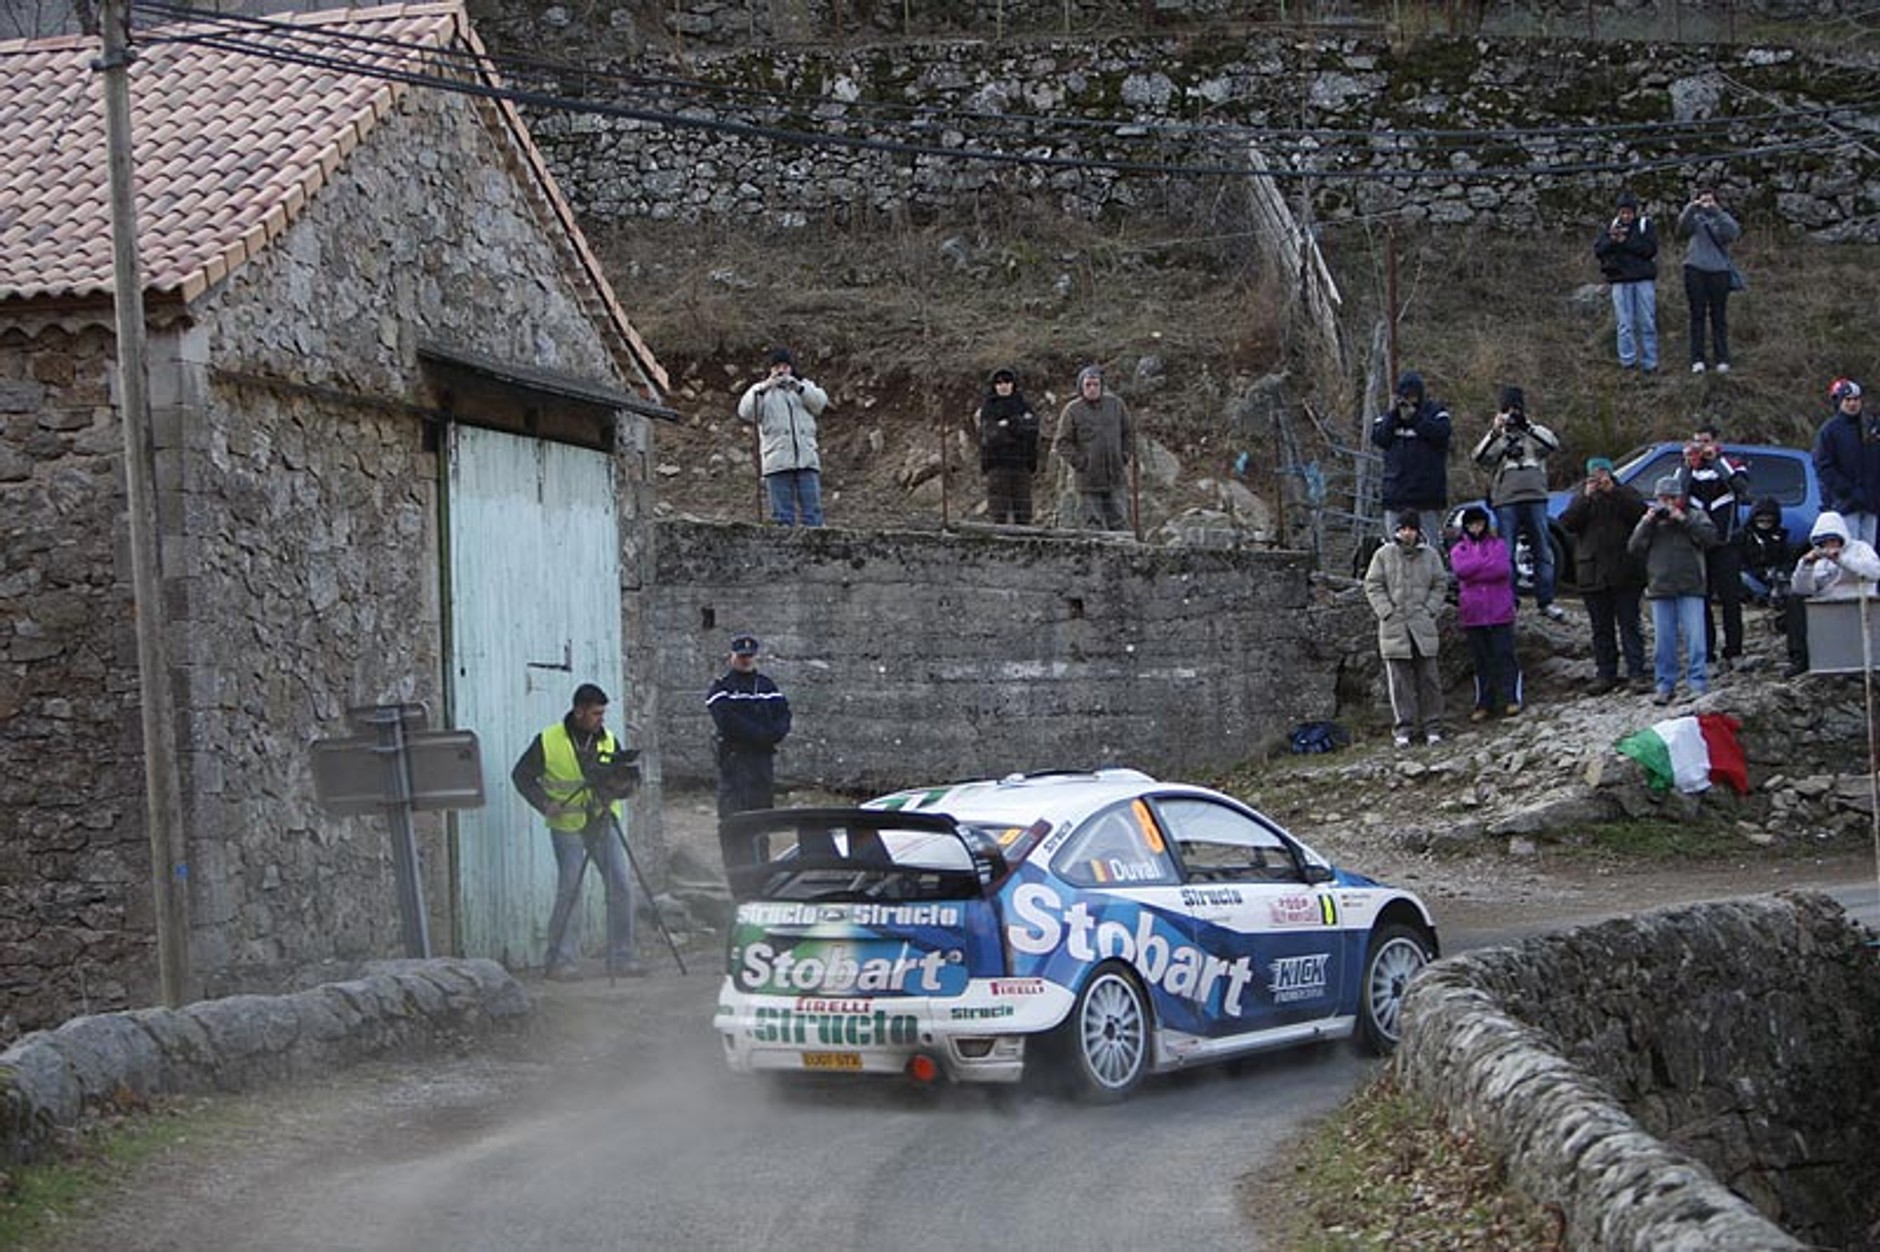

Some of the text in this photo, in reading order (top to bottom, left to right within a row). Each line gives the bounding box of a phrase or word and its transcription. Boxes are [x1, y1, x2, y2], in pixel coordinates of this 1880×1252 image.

[1131, 798, 1165, 854] 8
[1109, 858, 1161, 880] Duval
[852, 904, 958, 926] Structo
[741, 942, 946, 991] Stobart
[1009, 882, 1253, 1017] Stobart
[795, 996, 873, 1013] PIRELLI
[754, 1006, 919, 1046] Structo
